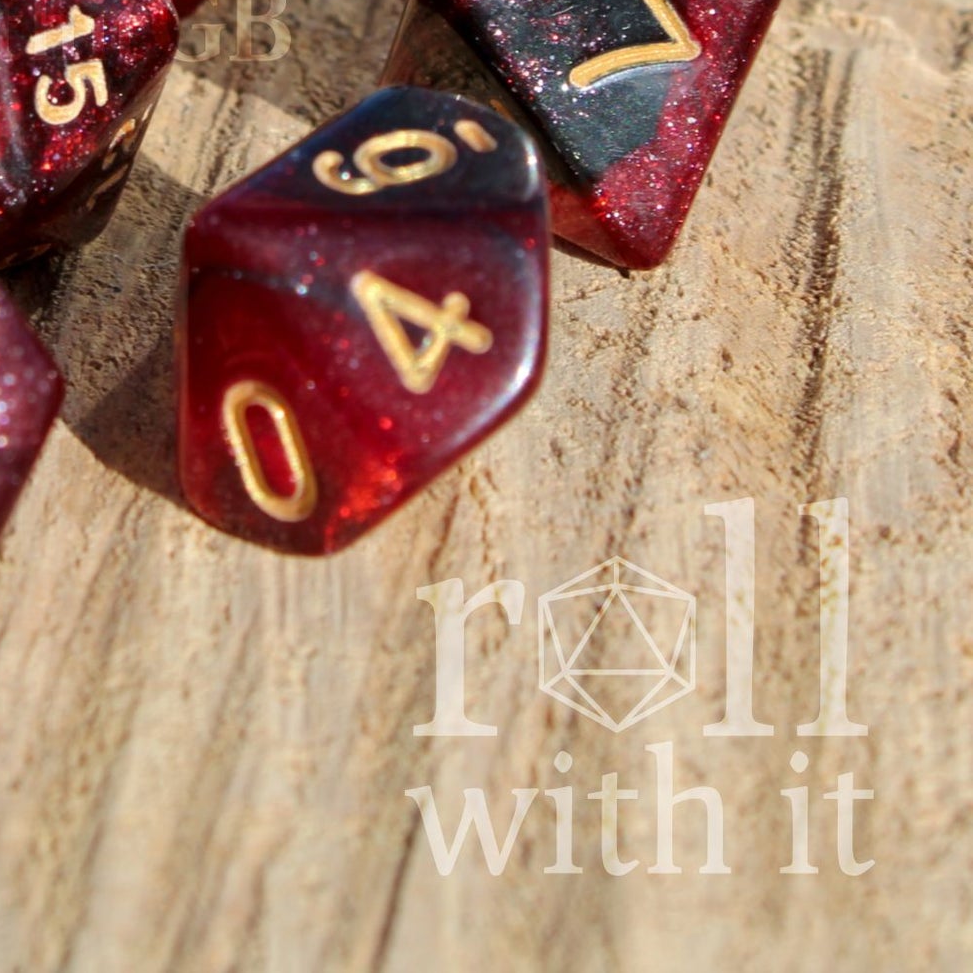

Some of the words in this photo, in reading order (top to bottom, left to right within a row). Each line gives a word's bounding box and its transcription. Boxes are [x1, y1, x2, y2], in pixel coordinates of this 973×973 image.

[25, 5, 109, 125] 15
[350, 270, 494, 395] 4
[222, 380, 317, 522] 0
